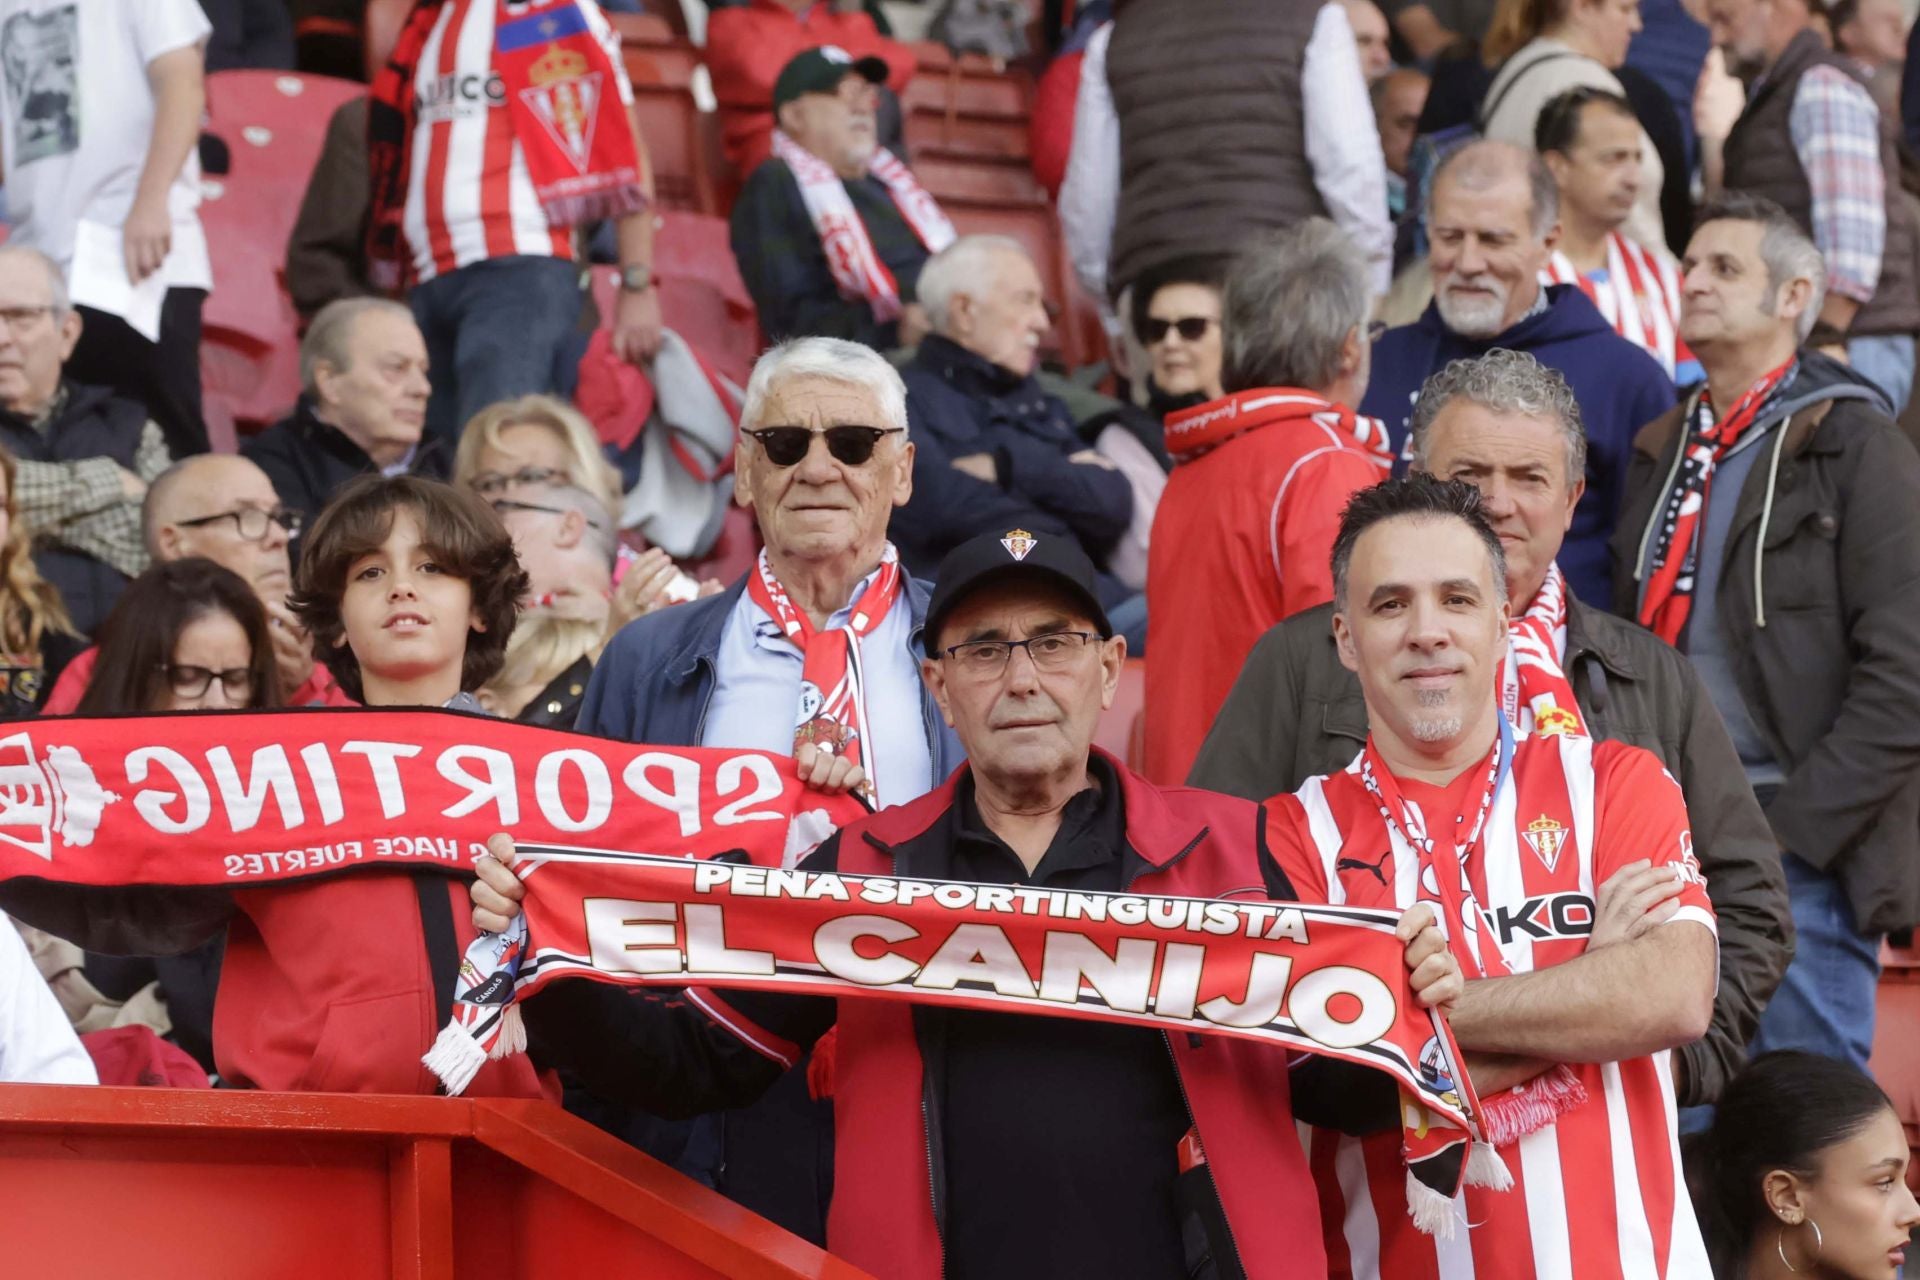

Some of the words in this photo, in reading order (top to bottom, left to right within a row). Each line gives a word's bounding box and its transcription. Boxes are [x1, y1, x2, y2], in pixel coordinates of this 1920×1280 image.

[858, 877, 1310, 945] SPORTINGUISTA
[583, 897, 776, 975] EL
[812, 913, 1396, 1049] CANIJO
